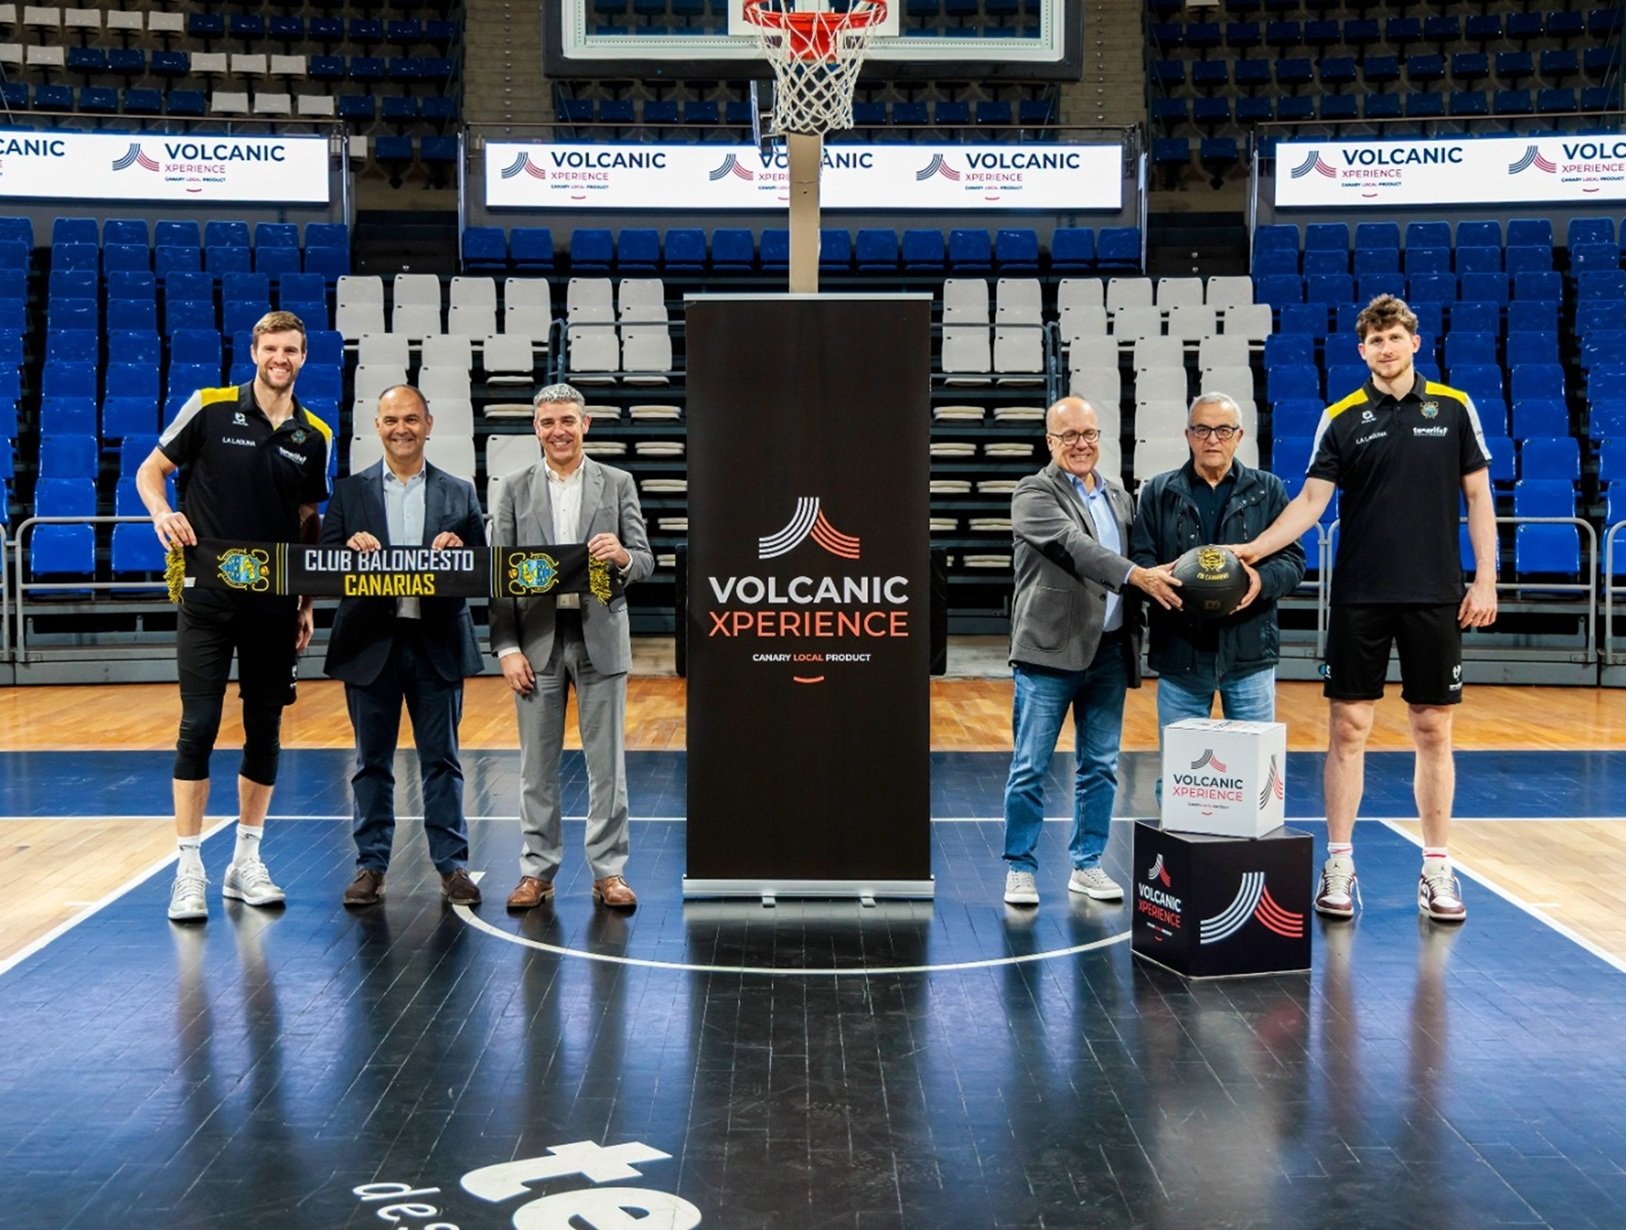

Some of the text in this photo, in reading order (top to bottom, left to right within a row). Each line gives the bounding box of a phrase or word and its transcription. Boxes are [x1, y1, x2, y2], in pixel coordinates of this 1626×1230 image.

[165, 143, 285, 162] VOLCANIC
[551, 151, 666, 169] VOLCANIC
[759, 152, 873, 168] VOANIC
[1342, 147, 1463, 165] VOLCANIC
[165, 164, 226, 174] XPERIENCE
[966, 153, 1080, 169] VOLCANIC
[1562, 163, 1624, 173] XPERIENCE
[551, 172, 609, 181] XPERIENCE
[966, 173, 1023, 182] XPERIENCE
[1342, 169, 1402, 178] XPERIENCE
[305, 550, 474, 572] CLUB BALONCESTO
[345, 574, 435, 596] CANARIAS
[708, 576, 909, 604] VOLCANIC
[708, 611, 909, 637] XPERIENCE
[752, 653, 871, 662] CANARY LOCAL PRODUCT
[1173, 774, 1243, 789] VOLCANIC
[1172, 787, 1243, 802] XPERIENCE
[1138, 882, 1182, 912] VOLCANIC
[1138, 899, 1181, 928] XPERIENCE
